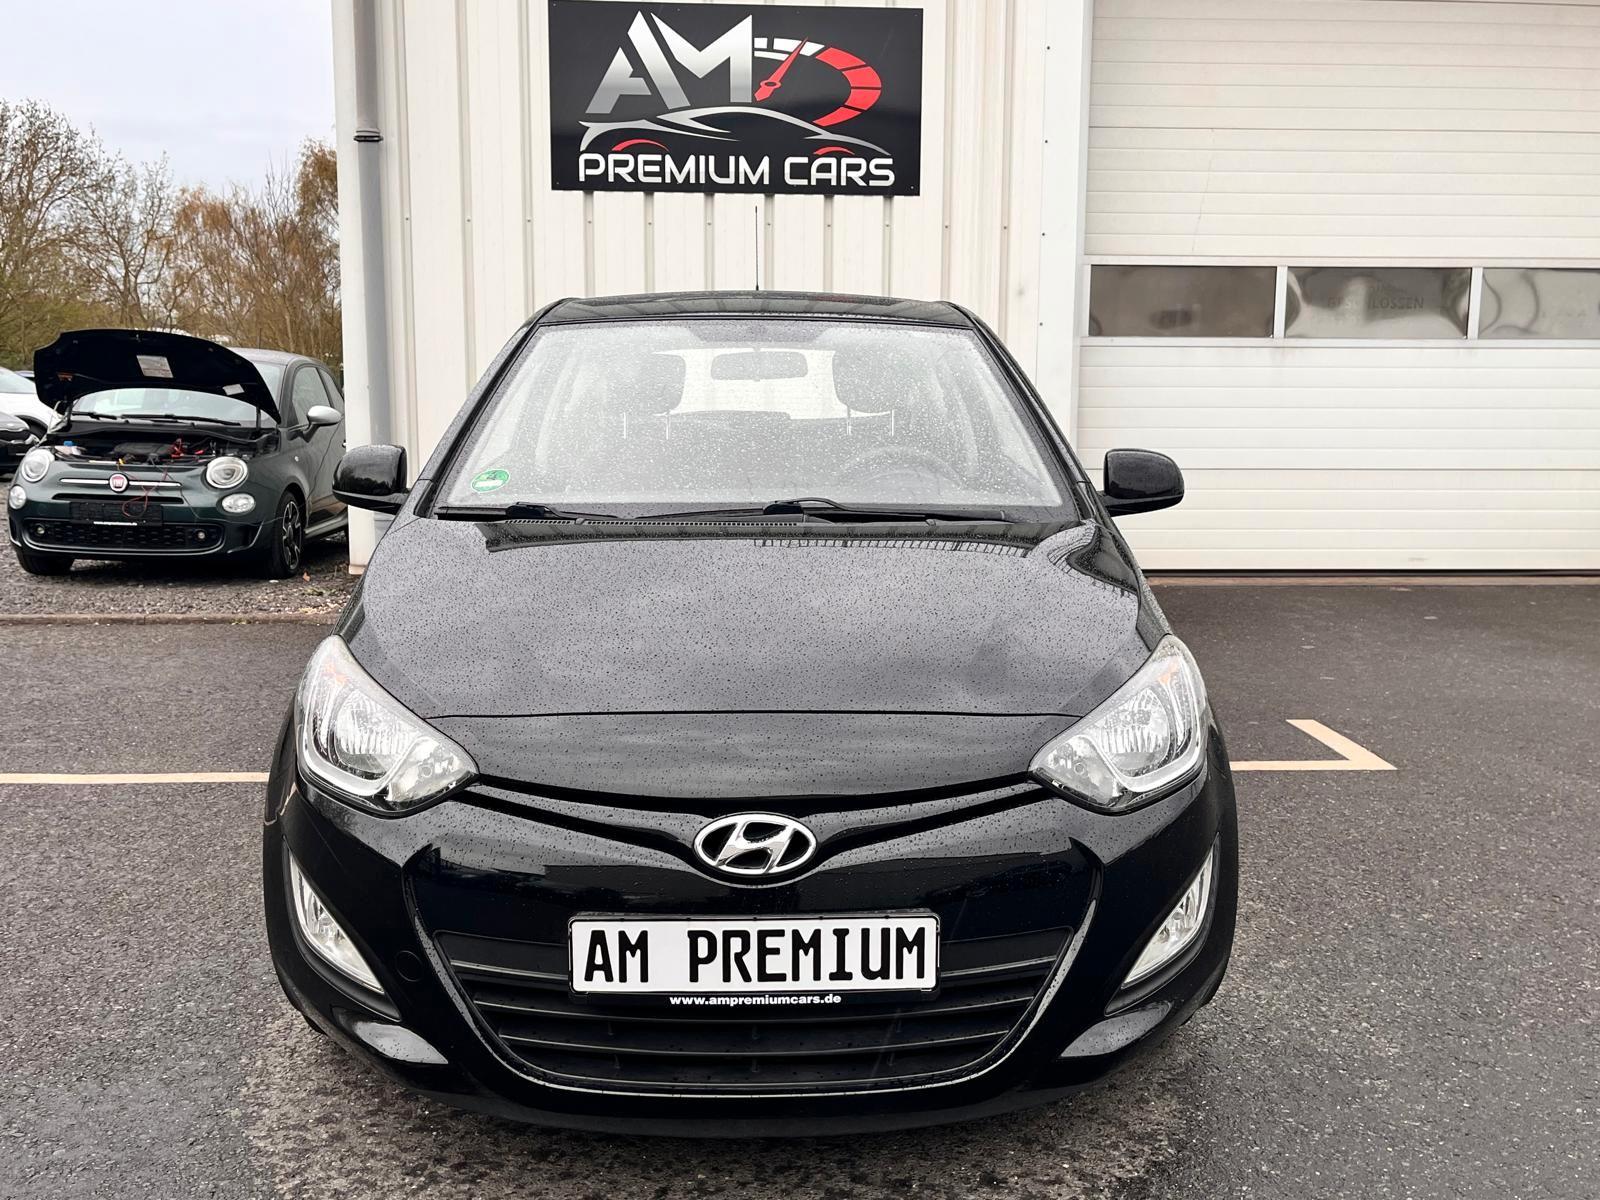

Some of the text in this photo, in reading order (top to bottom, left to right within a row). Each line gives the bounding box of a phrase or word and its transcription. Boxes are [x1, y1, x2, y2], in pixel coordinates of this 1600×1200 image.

[579, 153, 895, 187] PREMIUM CARS
[584, 927, 925, 983] AM PREMIUM
[669, 994, 842, 1006] www.ampremiumcars.de
